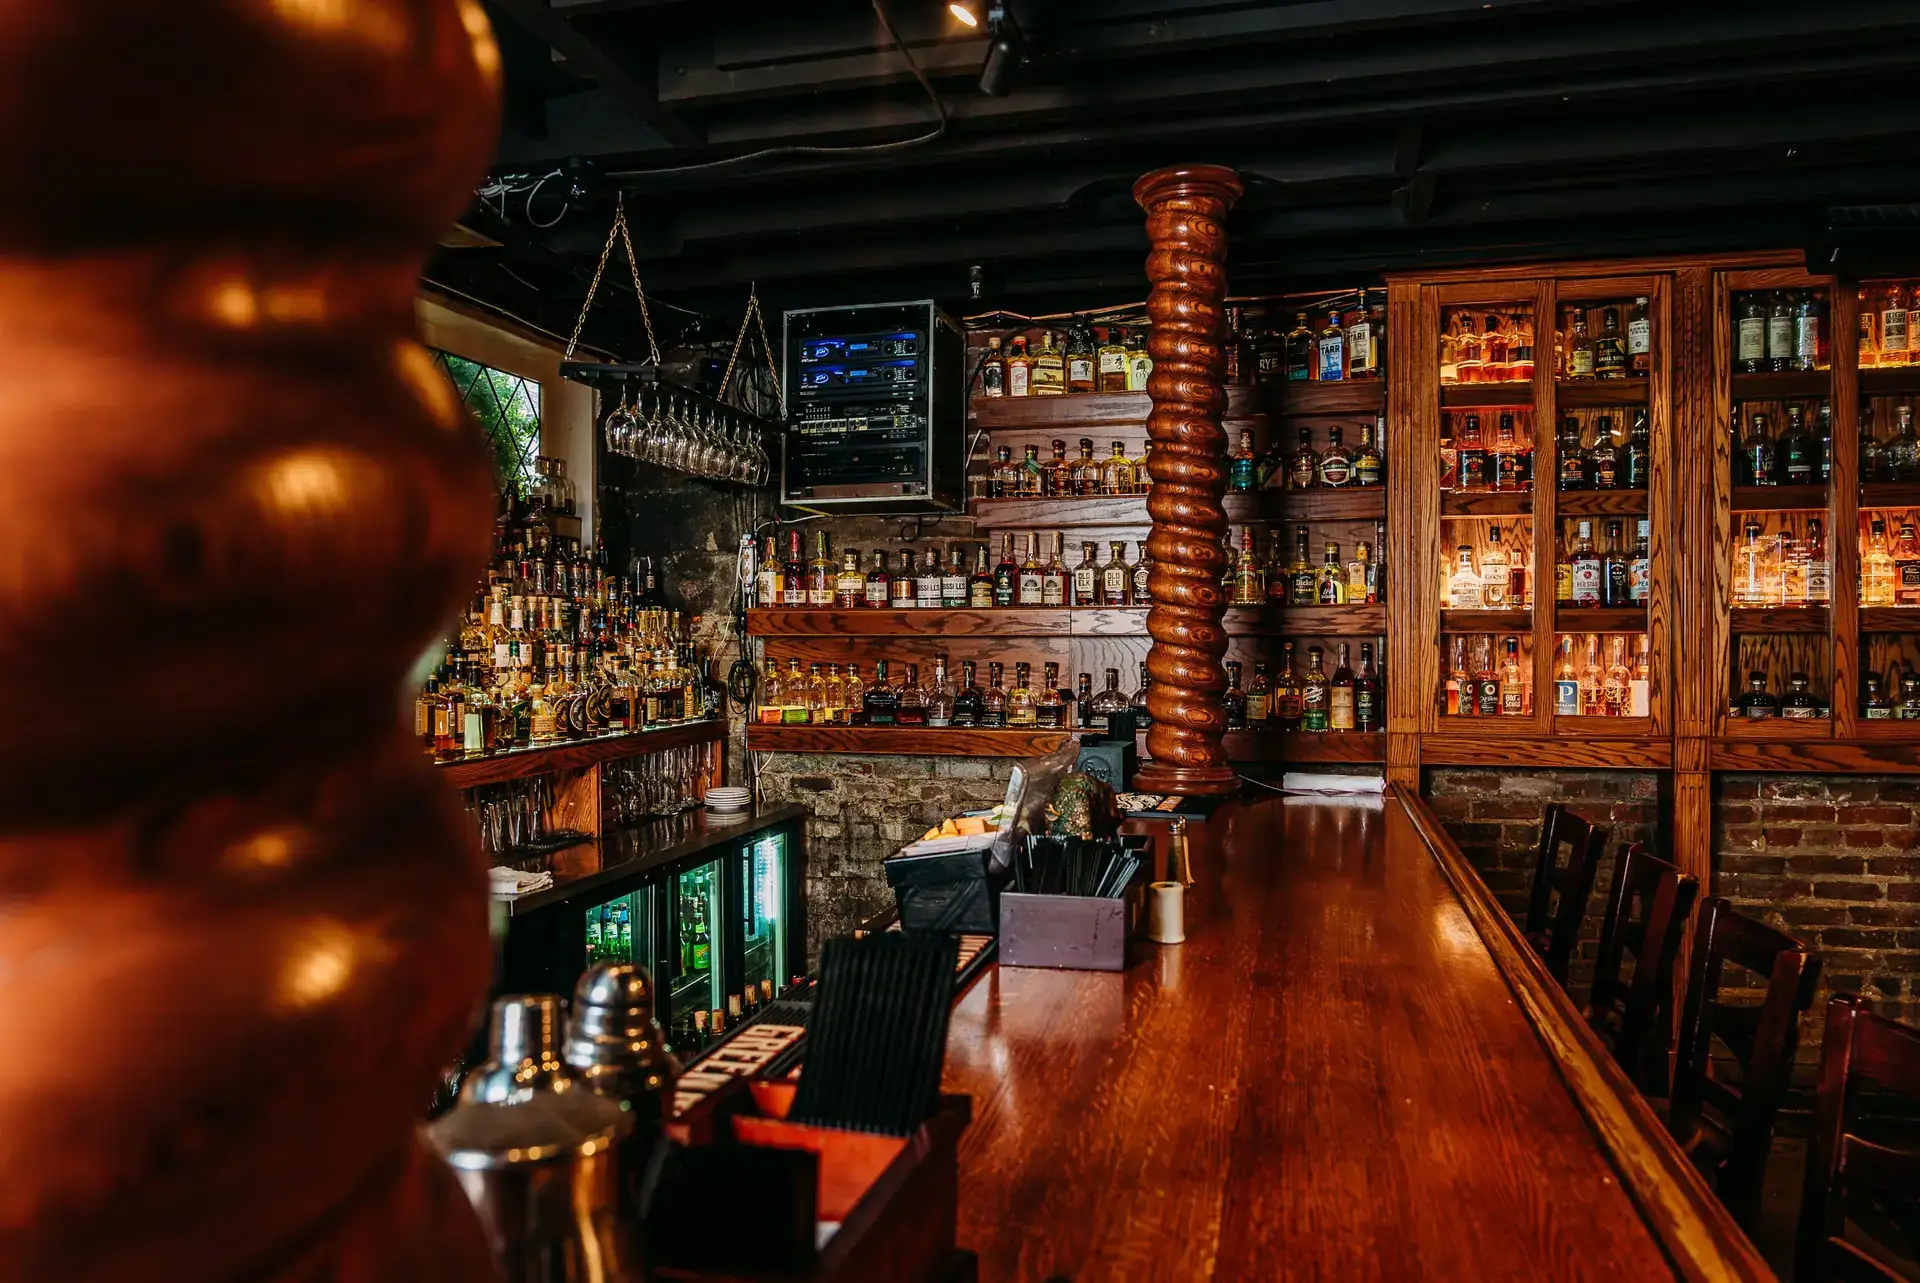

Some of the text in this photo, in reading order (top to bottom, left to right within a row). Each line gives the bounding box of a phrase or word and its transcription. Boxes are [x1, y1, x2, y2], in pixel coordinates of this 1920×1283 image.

[1321, 345, 1341, 355] TARR
[1259, 358, 1279, 368] RYE
[1575, 563, 1598, 574] JIM BEAM
[1560, 686, 1574, 703] P
